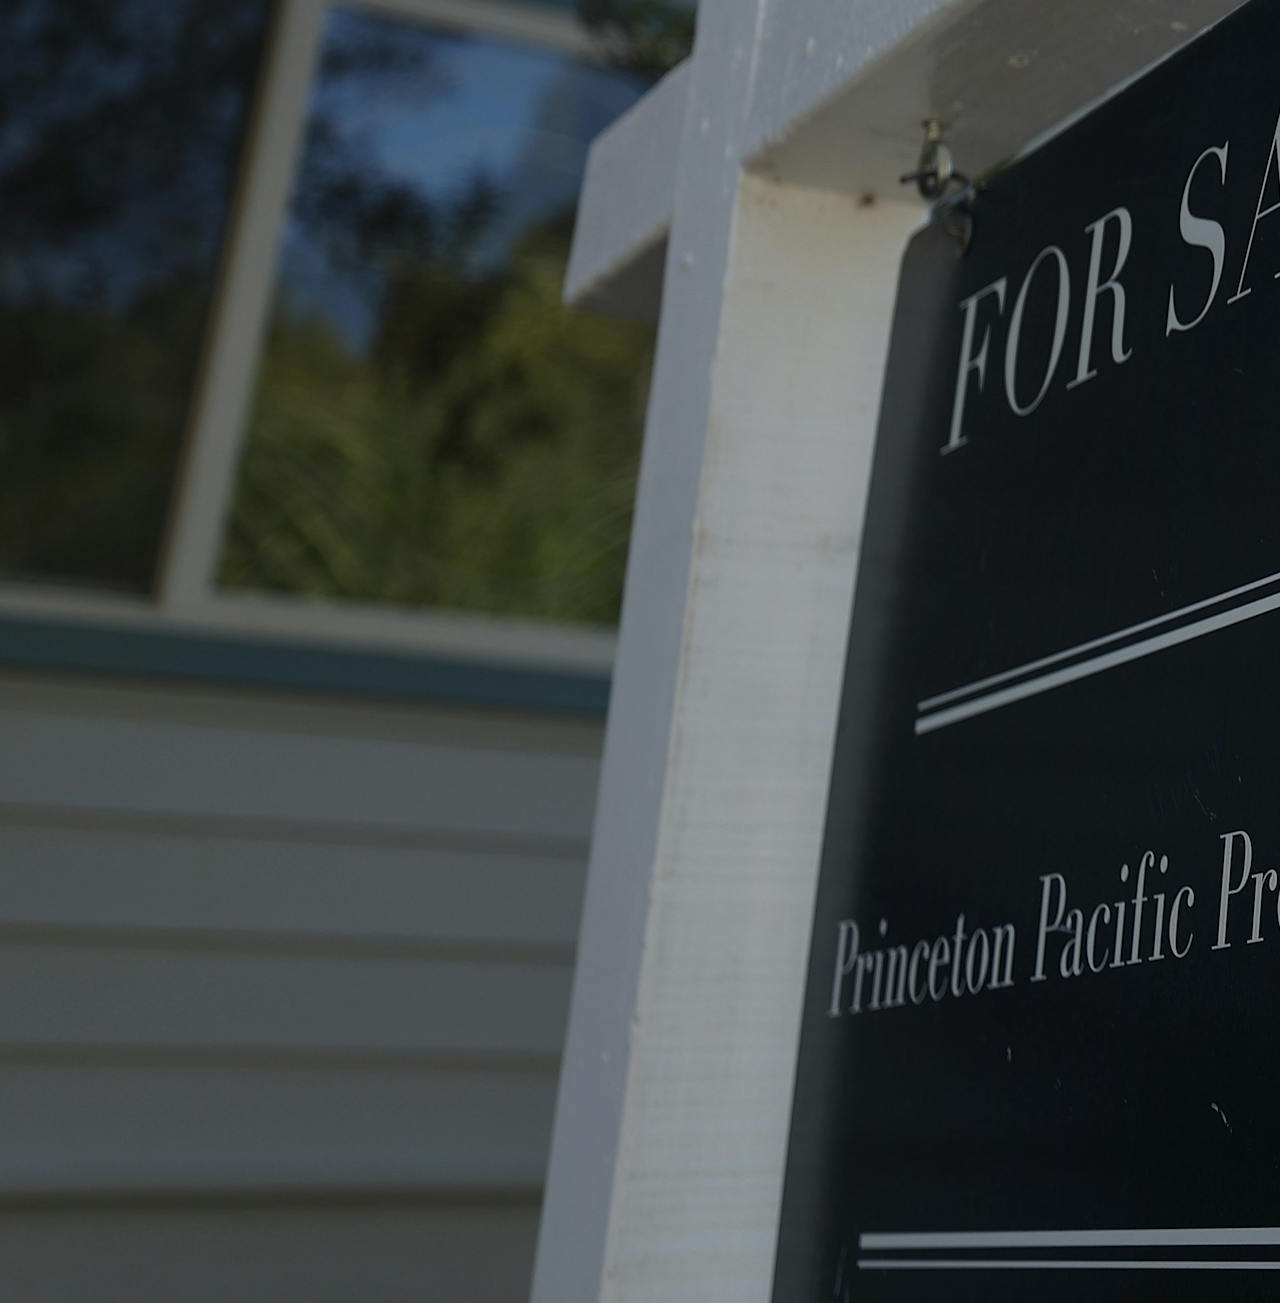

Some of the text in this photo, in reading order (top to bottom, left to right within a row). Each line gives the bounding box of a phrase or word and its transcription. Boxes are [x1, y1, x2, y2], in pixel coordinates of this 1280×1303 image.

[939, 206, 1133, 456] FOR
[827, 912, 1016, 1019] Princeton
[1029, 850, 1196, 983] Pacific
